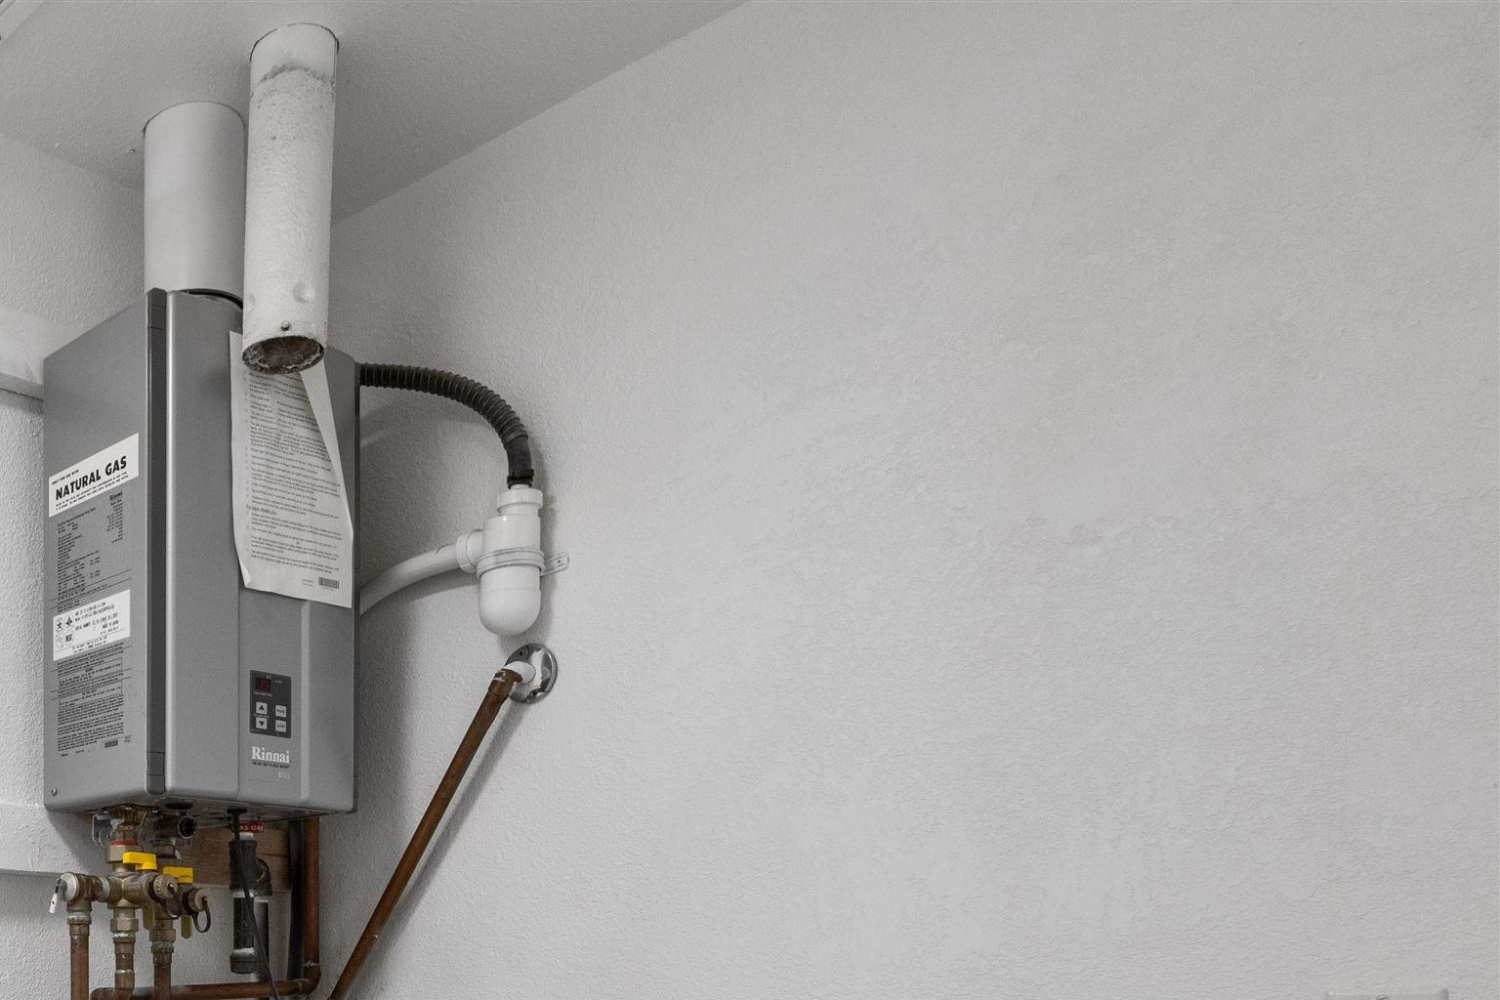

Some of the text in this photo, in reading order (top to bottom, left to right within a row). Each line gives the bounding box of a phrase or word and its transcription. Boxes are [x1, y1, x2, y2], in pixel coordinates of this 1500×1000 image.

[55, 469, 102, 501] NATURAL
[105, 455, 127, 476] GAS
[251, 746, 290, 764] Rinnai
